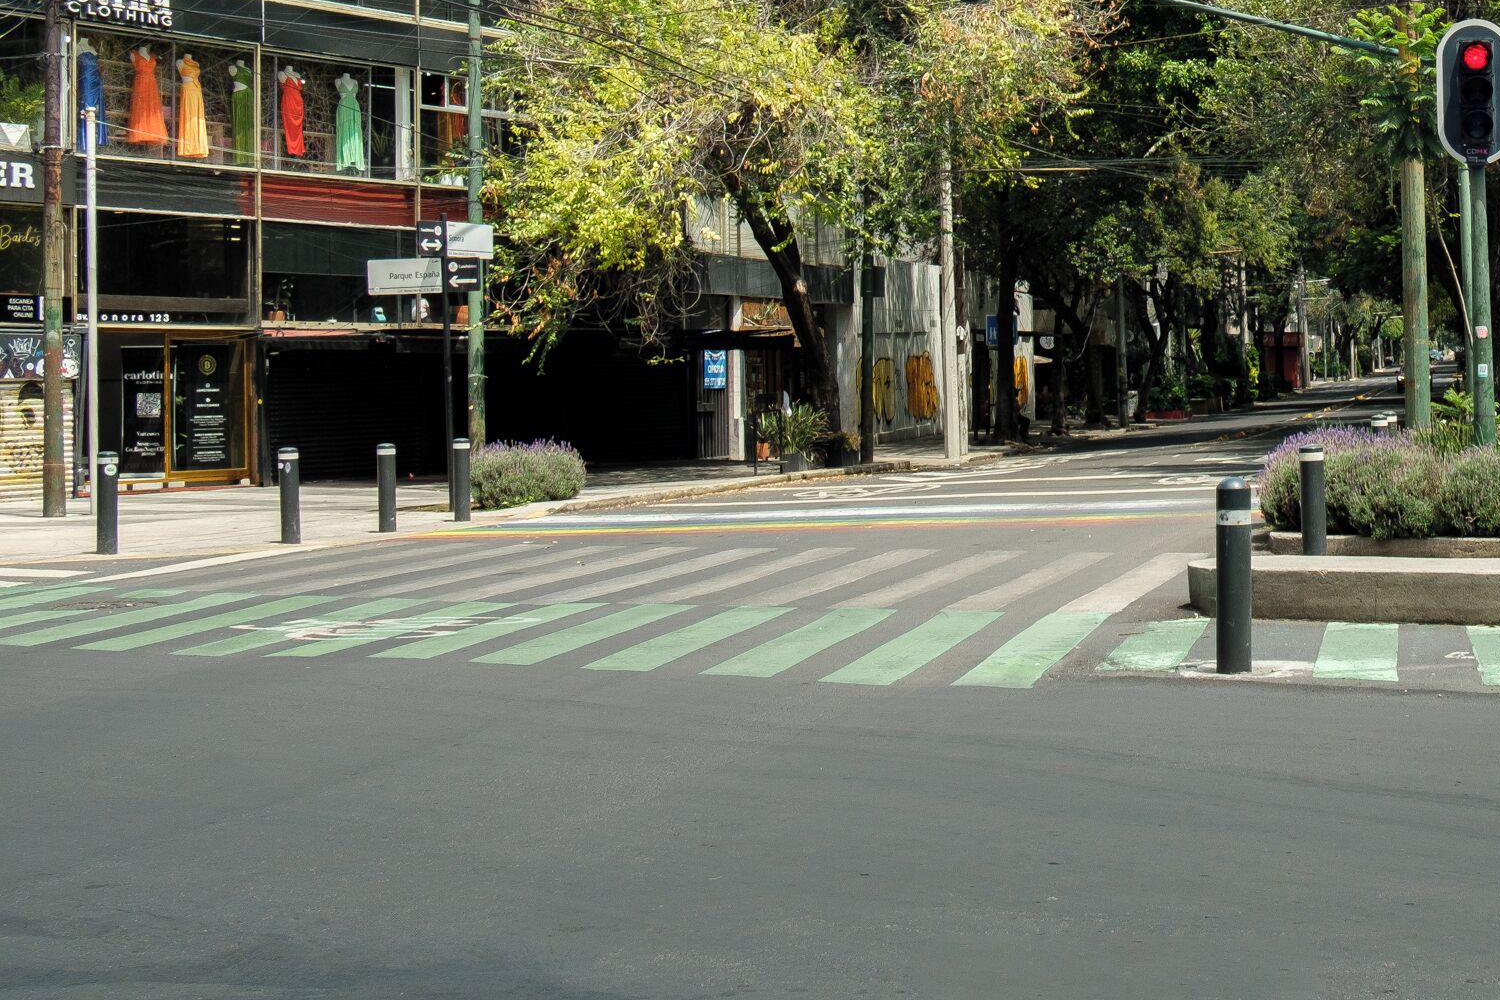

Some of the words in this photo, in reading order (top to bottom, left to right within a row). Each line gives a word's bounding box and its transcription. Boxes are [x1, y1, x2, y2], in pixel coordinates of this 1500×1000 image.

[67, 1, 173, 27] CLOTHING
[0, 161, 36, 189] R
[389, 272, 413, 281] Parque
[415, 270, 440, 281] España
[101, 313, 144, 322] onora
[150, 313, 170, 322] 123
